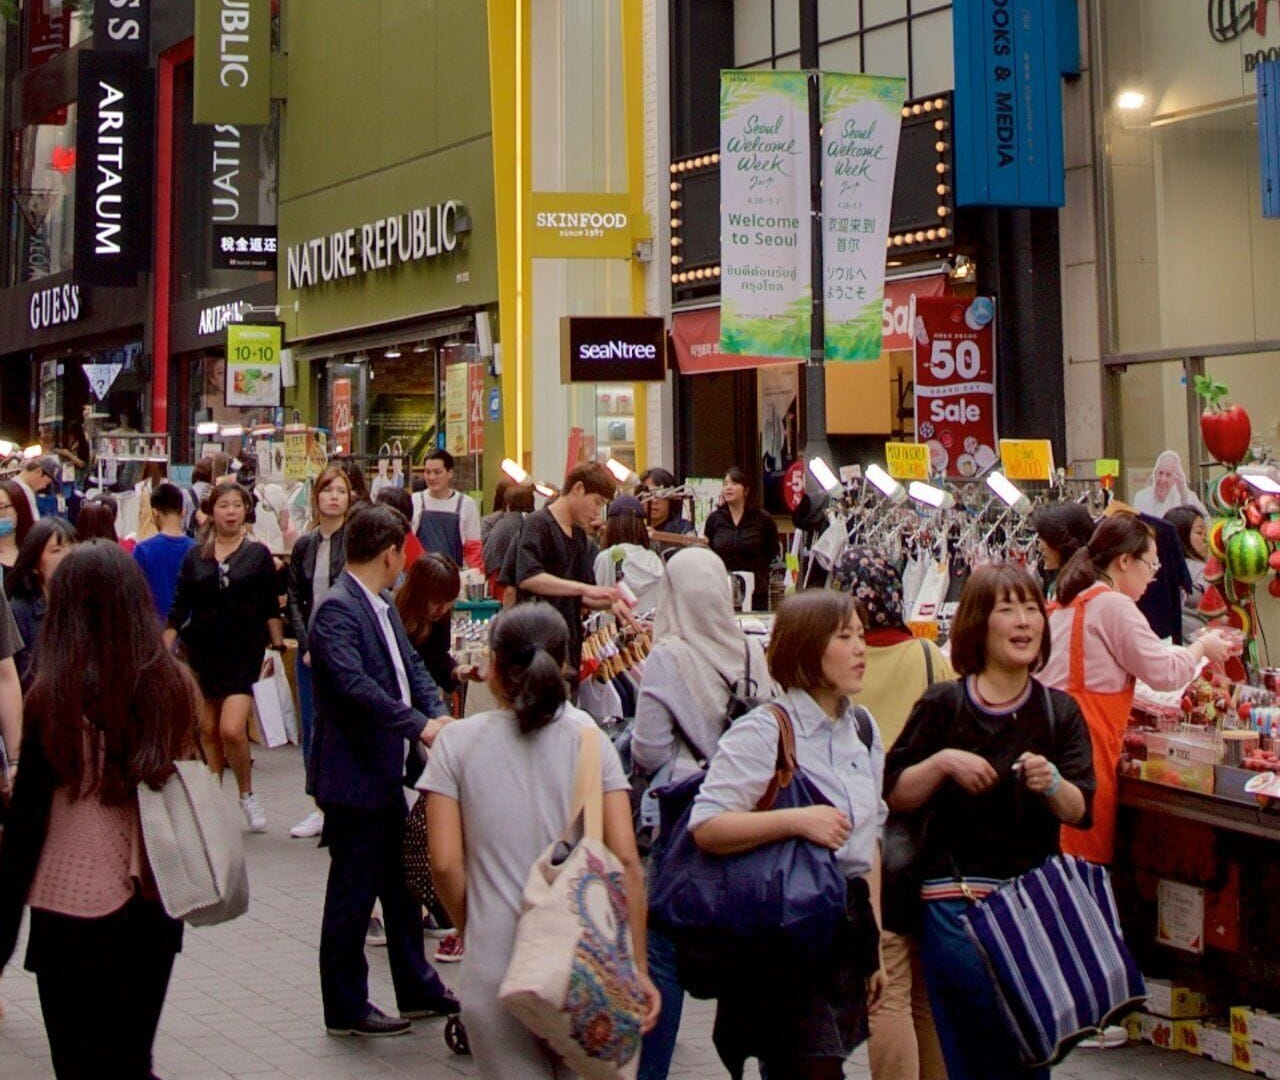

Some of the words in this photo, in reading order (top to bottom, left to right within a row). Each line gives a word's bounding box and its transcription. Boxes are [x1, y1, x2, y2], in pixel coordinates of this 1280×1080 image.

[994, 65, 1011, 83] &
[743, 114, 783, 135] Seoul
[841, 118, 878, 140] Seoul
[995, 91, 1015, 169] MEDIA
[727, 135, 803, 155] Welcome
[827, 140, 888, 160] Welcome
[95, 81, 124, 255] ARITAUM
[737, 152, 792, 178] Week
[834, 157, 876, 182] Week
[536, 212, 627, 229] SKINFOOD
[728, 213, 800, 229] Welcome
[287, 228, 356, 290] NATURE
[362, 201, 458, 271] REPUBLIC
[732, 233, 749, 245] to
[755, 232, 797, 248] Seoul
[837, 238, 860, 253] 首尔
[827, 285, 867, 301] ようこそ
[30, 283, 80, 330] GUESS
[882, 293, 916, 341] Sal
[579, 341, 657, 360] seaNtree
[929, 340, 981, 379] 50
[930, 398, 981, 425] Sale
